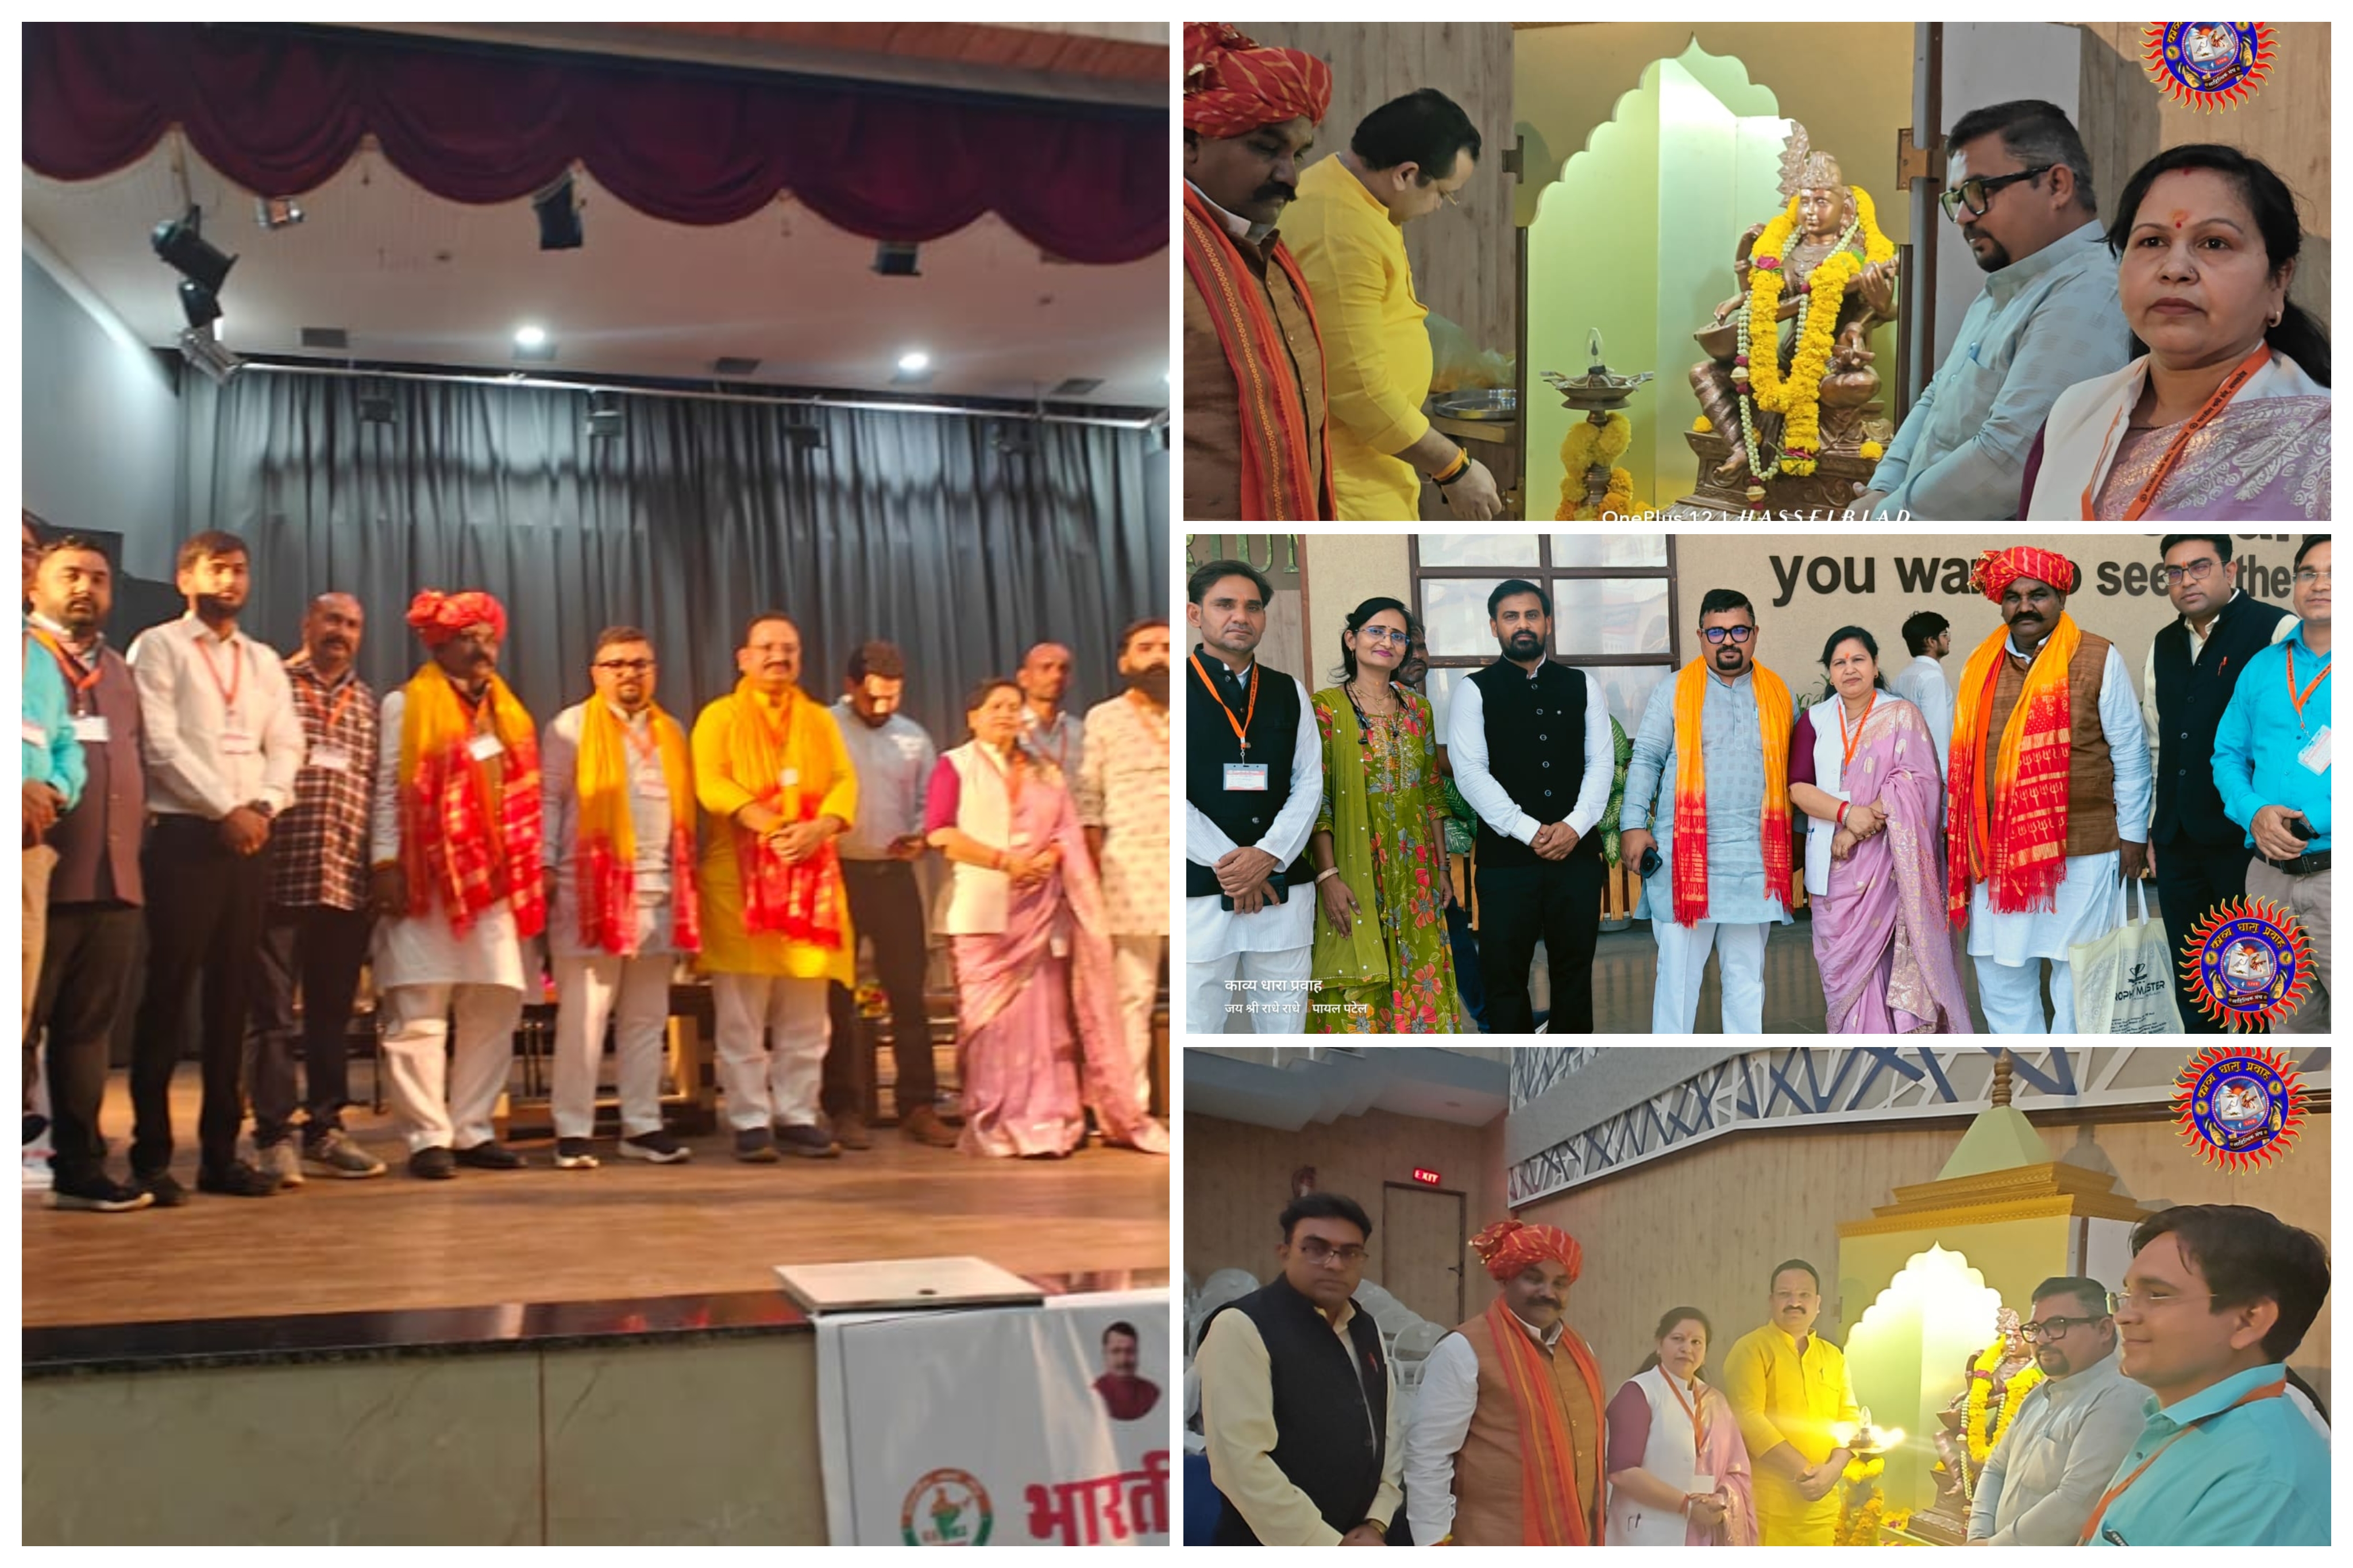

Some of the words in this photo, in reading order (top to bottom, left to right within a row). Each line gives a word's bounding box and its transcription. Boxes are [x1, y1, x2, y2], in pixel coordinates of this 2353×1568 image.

[1769, 555, 1875, 607] you
[1893, 557, 1980, 594] wa
[1414, 1169, 1438, 1183] EXIT
